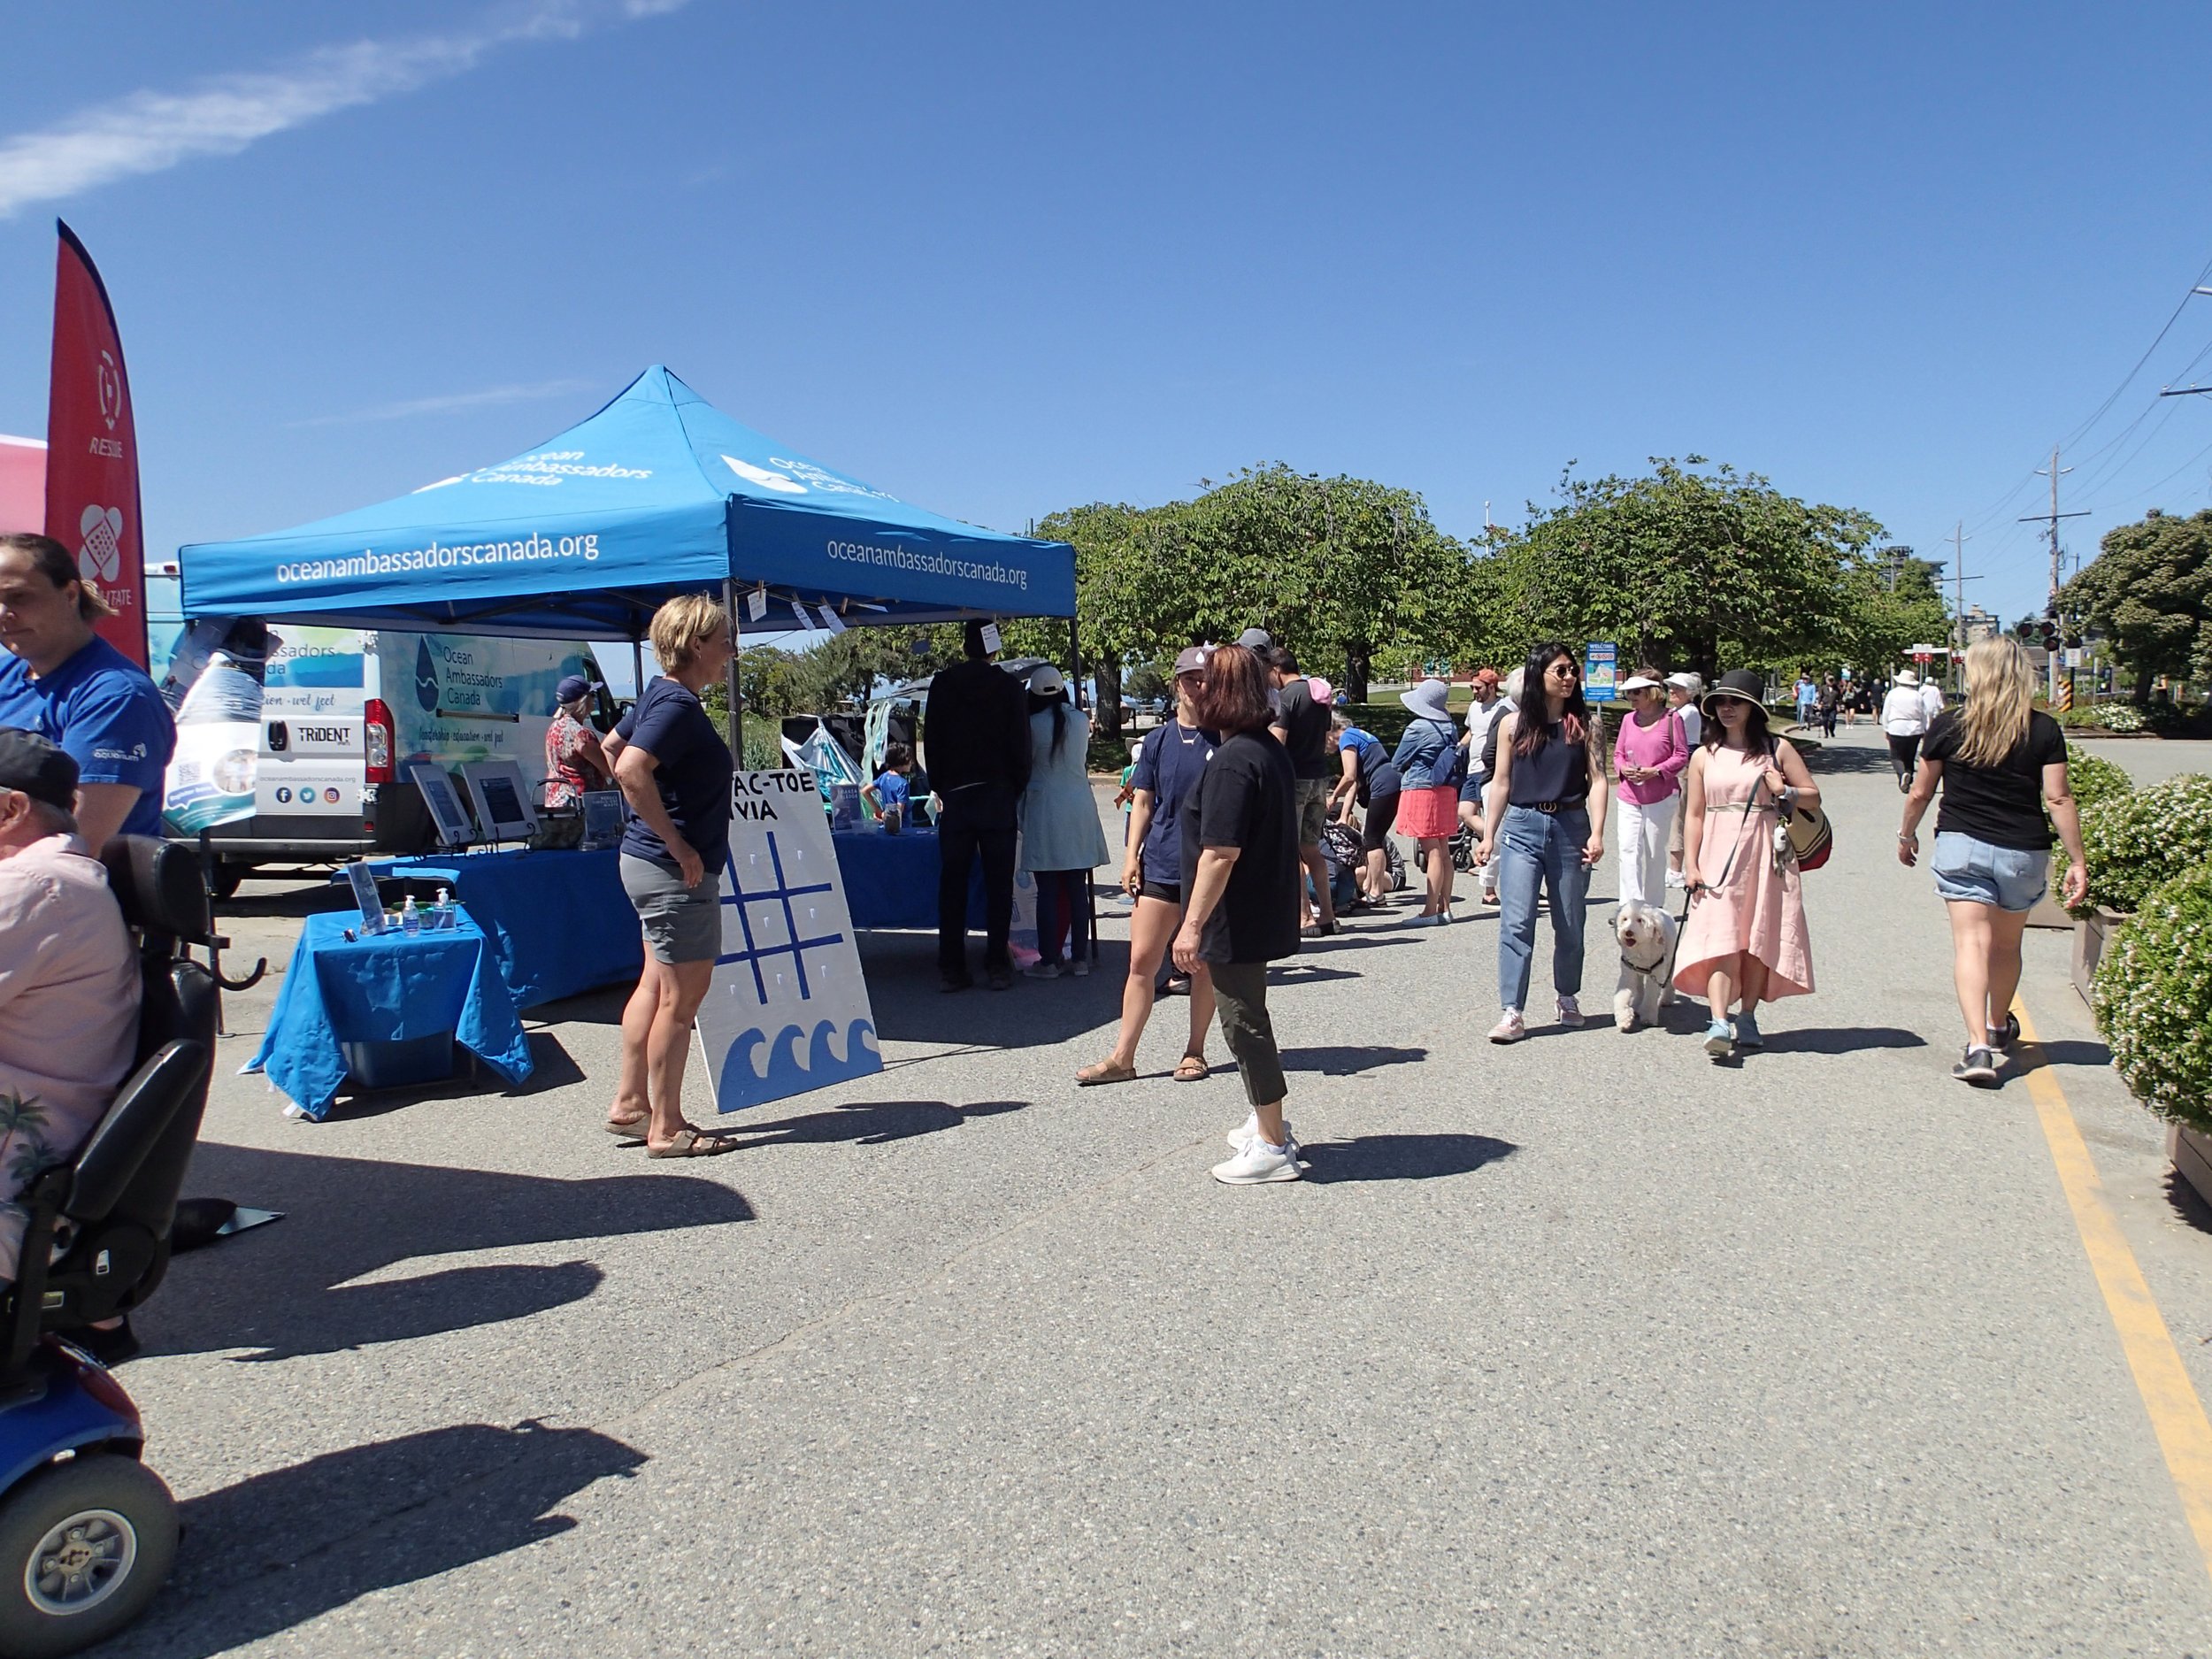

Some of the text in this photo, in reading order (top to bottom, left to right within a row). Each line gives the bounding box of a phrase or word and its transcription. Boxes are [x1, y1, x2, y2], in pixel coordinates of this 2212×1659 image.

[277, 532, 599, 583] oceanambassadorscanada.org
[826, 540, 1027, 590] oceanambassadorscanada.org
[271, 643, 336, 657] ssadors
[443, 646, 473, 665] Ocean
[446, 667, 503, 688] Ambassadors
[447, 687, 481, 705] Canada
[732, 772, 816, 797] AC-TOE
